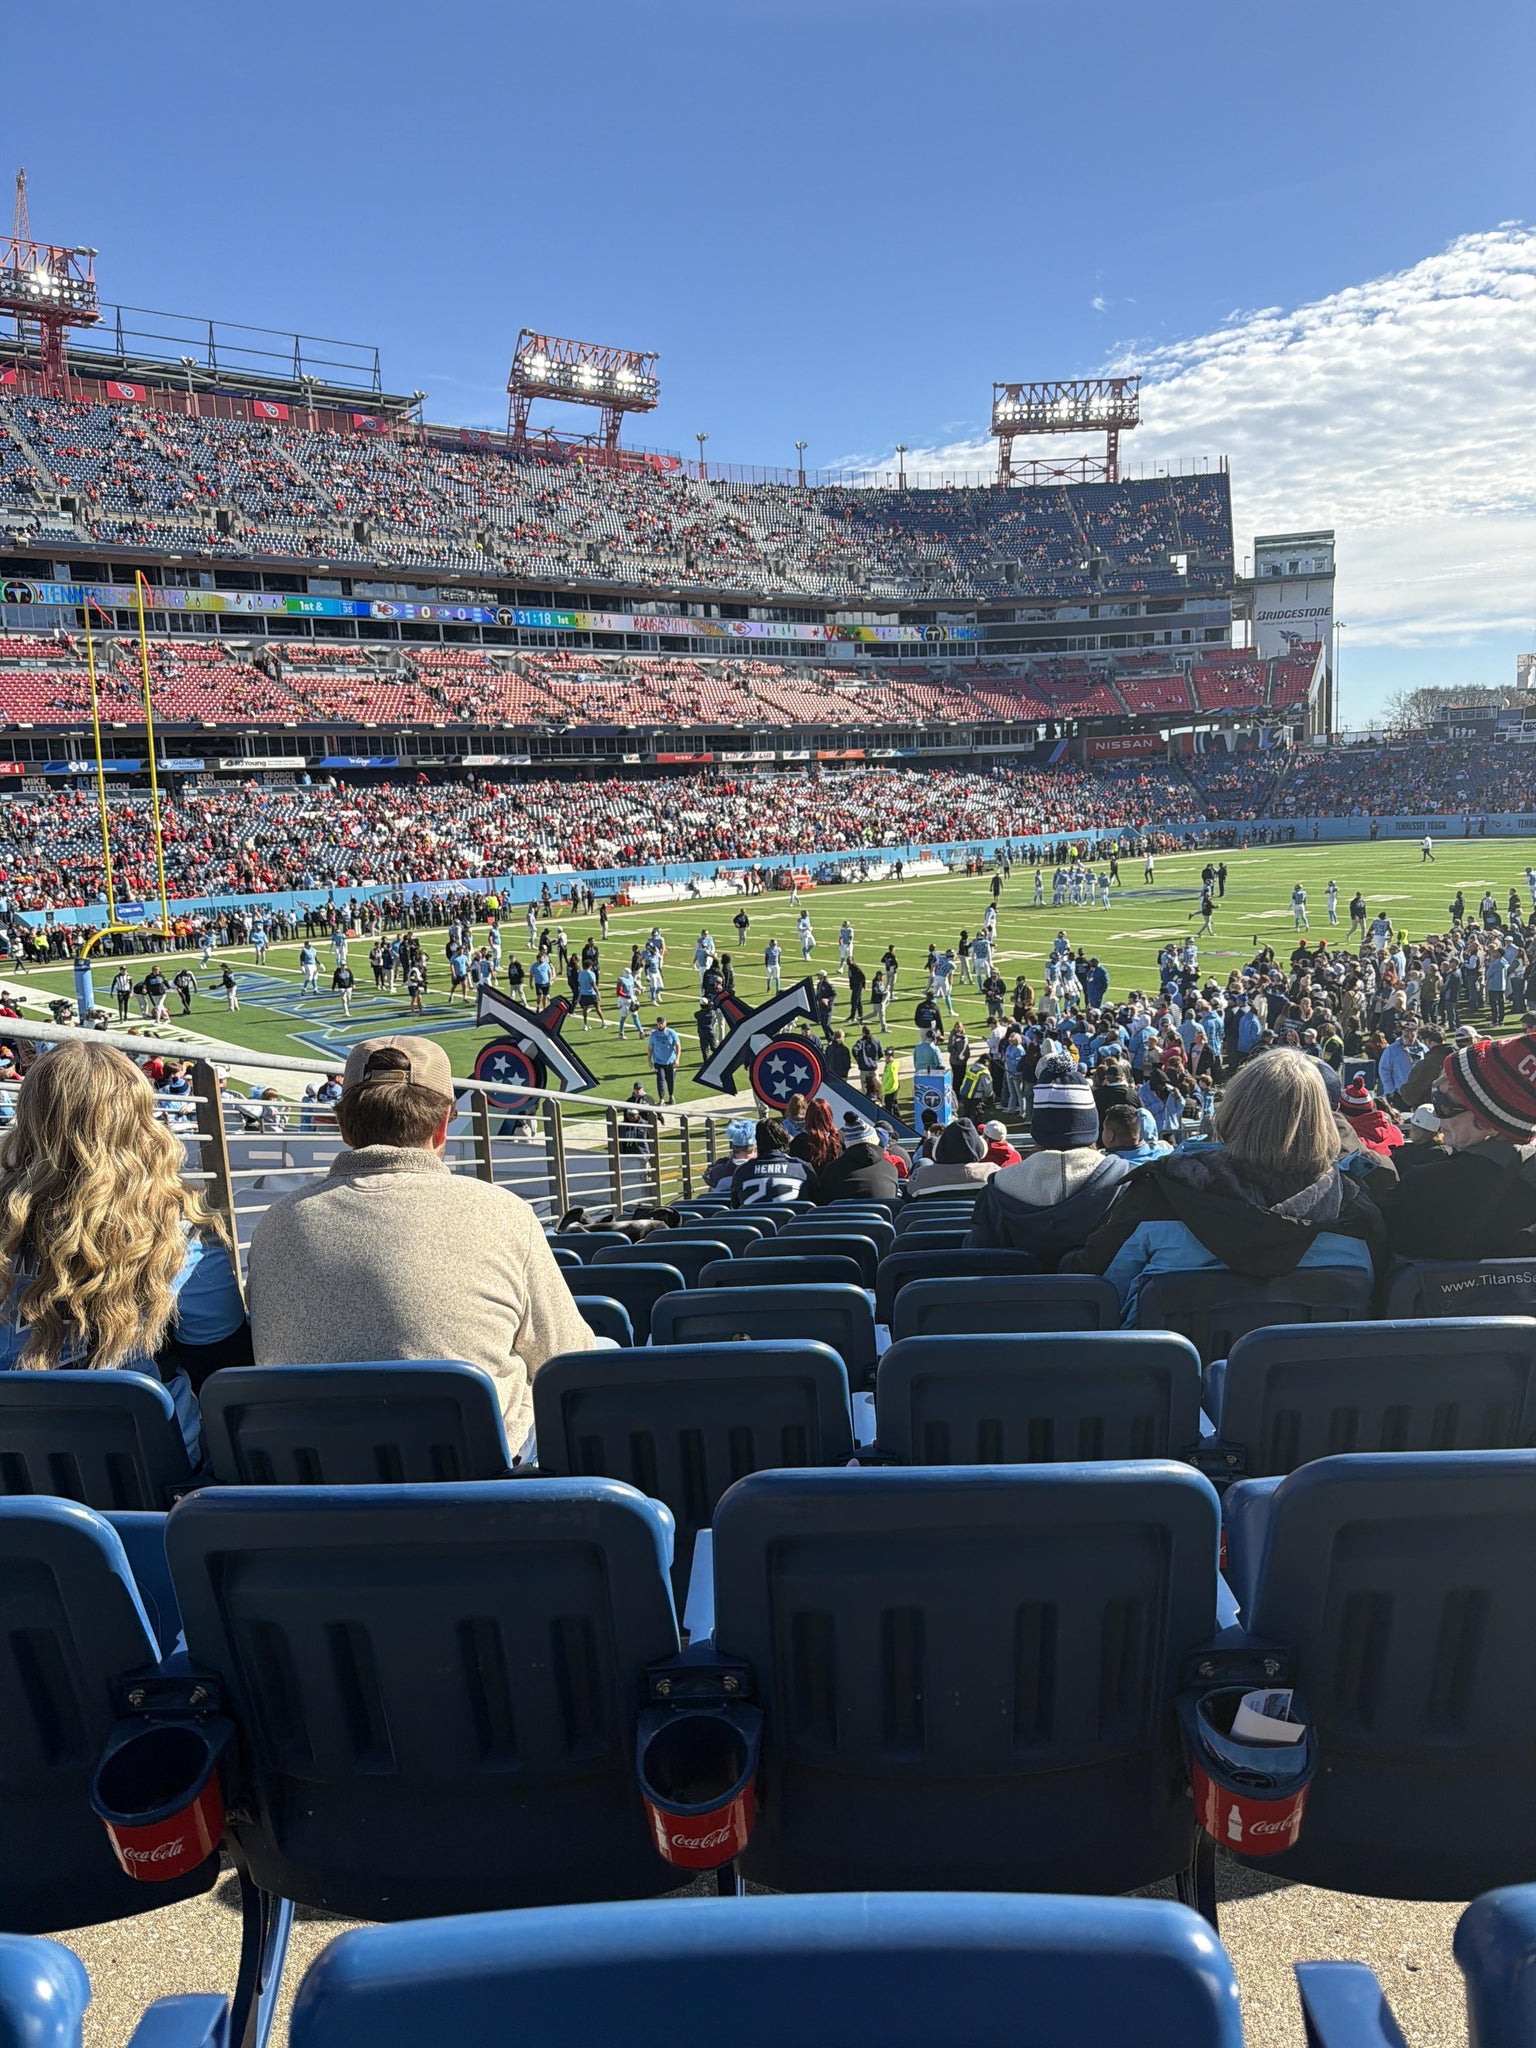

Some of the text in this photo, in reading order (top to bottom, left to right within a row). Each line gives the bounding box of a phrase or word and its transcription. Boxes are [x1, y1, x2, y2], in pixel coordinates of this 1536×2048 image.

[299, 600, 324, 612] 1st &
[343, 606, 352, 614] 35
[421, 605, 431, 619] 0
[457, 607, 467, 621] 0
[517, 611, 569, 625] 31:18 1st
[1257, 607, 1332, 620] BRIDGESTONE
[633, 615, 669, 633] KANSAS
[671, 617, 689, 634] CITY
[1096, 740, 1152, 750] NISSAN
[77, 777, 89, 790] 43
[754, 1163, 788, 1175] HENRY
[671, 1825, 732, 1849] Coca-Cola
[123, 1836, 185, 1862] Coca-Cola
